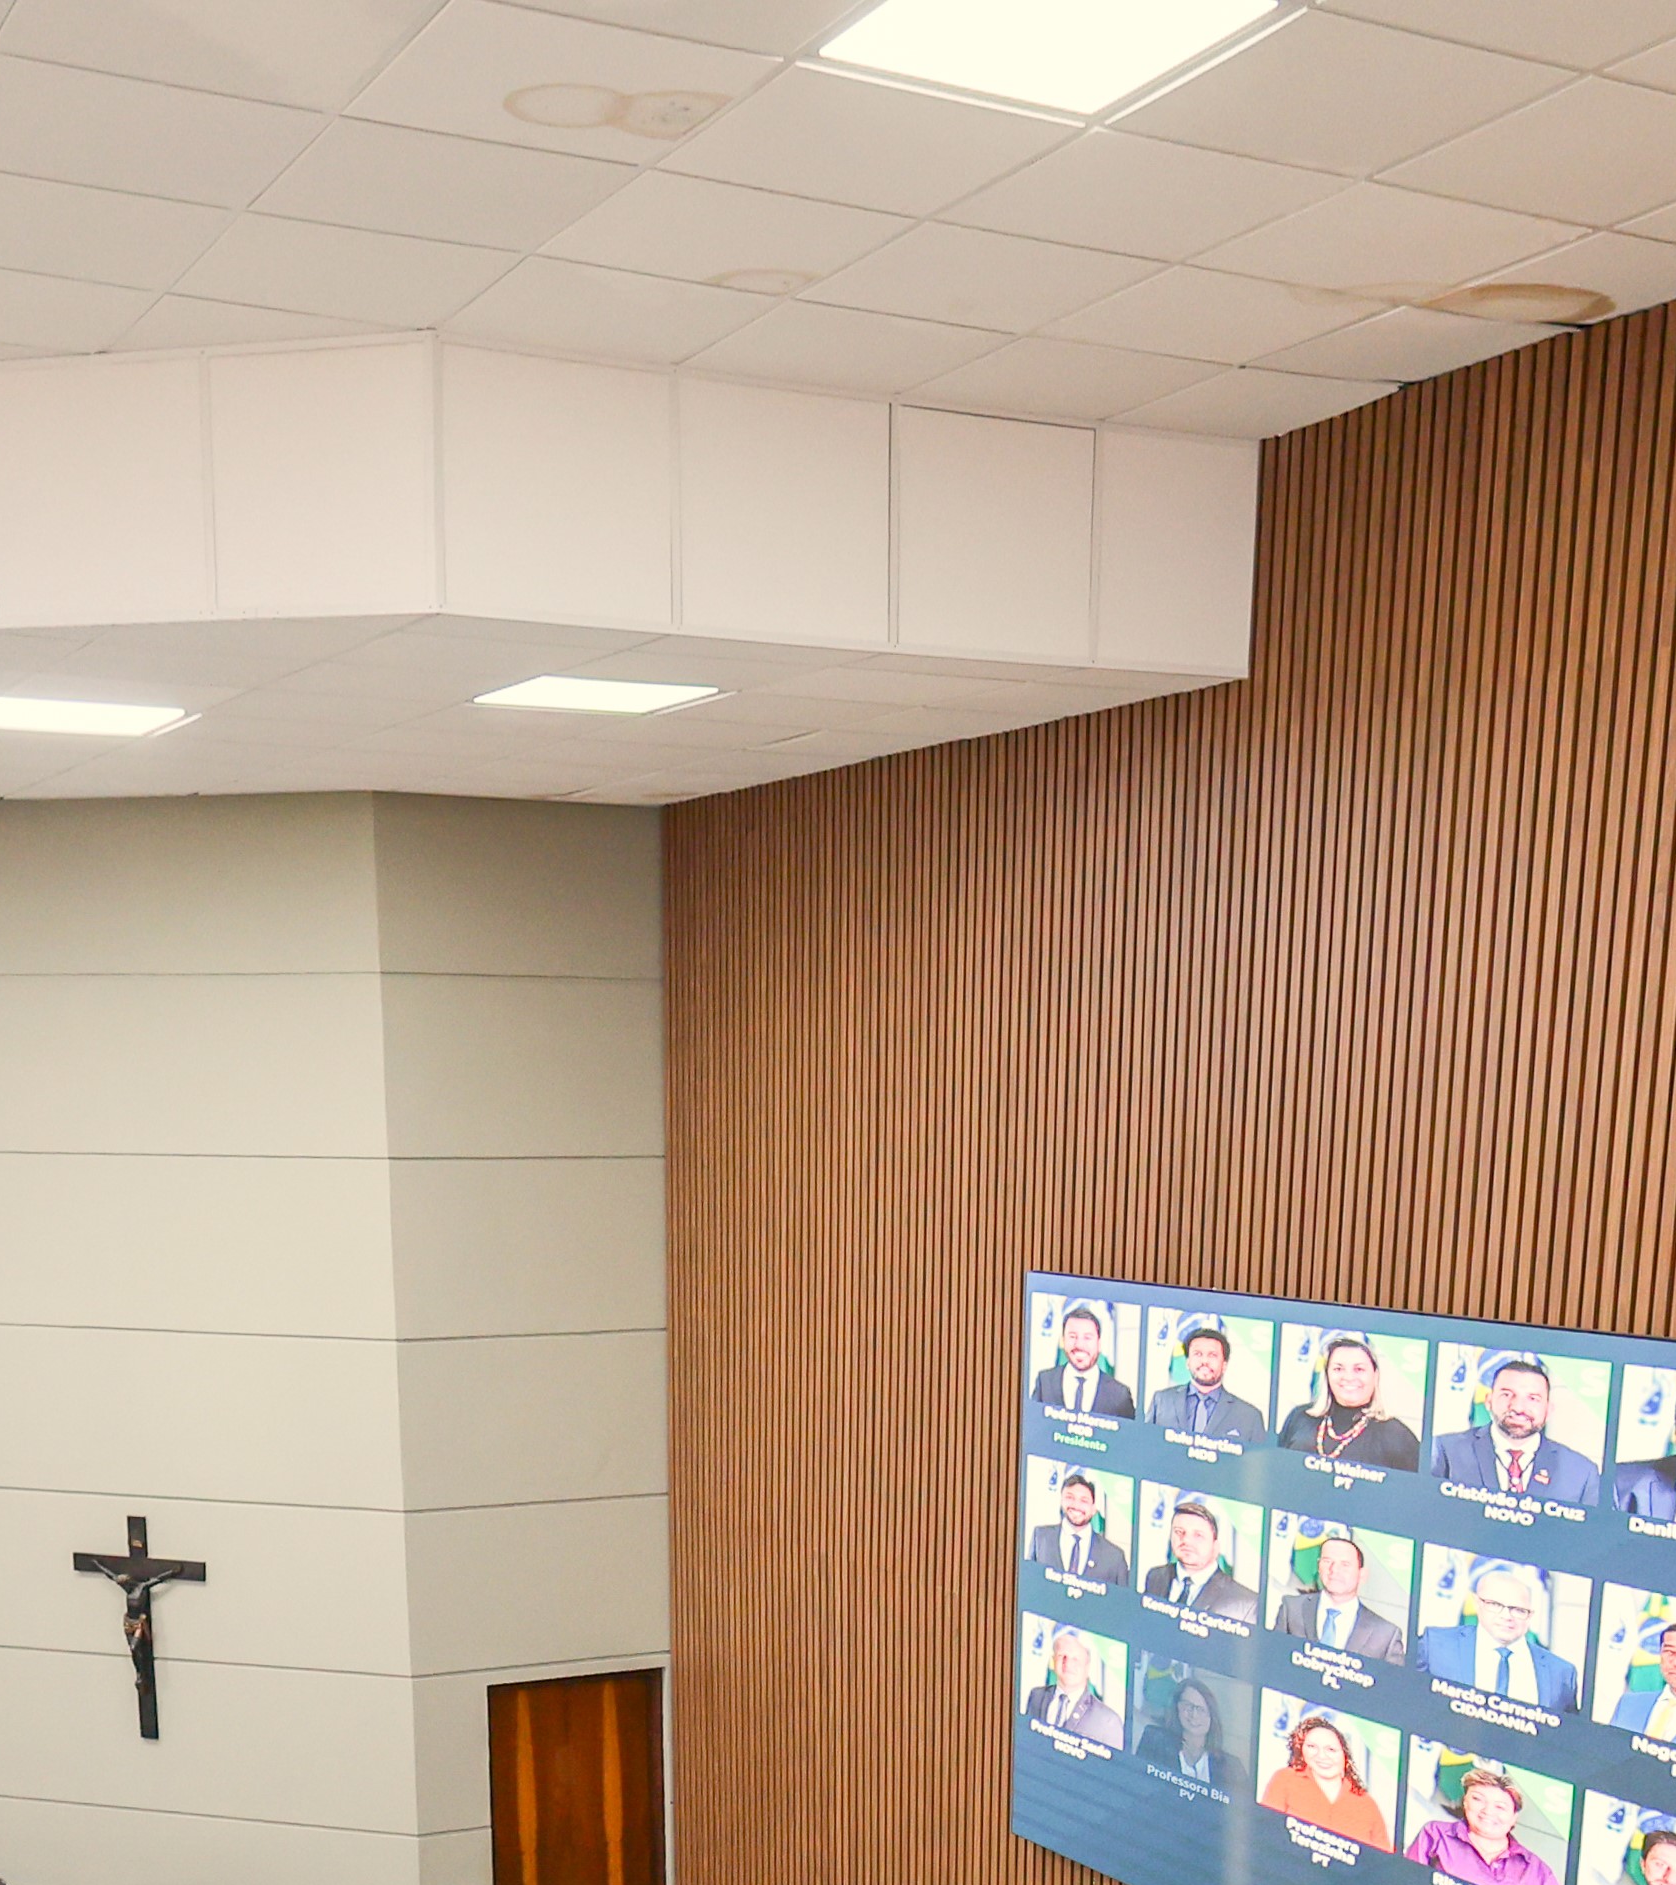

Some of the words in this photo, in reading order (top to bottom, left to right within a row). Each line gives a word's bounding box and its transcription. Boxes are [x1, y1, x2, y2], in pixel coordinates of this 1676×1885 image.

[1054, 1432, 1107, 1451] Presidente
[1187, 1446, 1217, 1463] MDB
[1304, 1456, 1333, 1473] Cris
[1334, 1475, 1354, 1490] PT
[1440, 1480, 1518, 1510] Cristóvão
[1518, 1495, 1542, 1514] da
[1543, 1500, 1586, 1523] Cruz
[1484, 1503, 1535, 1526] NOVO
[1142, 1595, 1179, 1619] Kenny
[1180, 1608, 1197, 1623] do
[1197, 1611, 1250, 1638] Cartório
[1180, 1620, 1209, 1638] MDB
[1304, 1642, 1363, 1670] Leandro
[1291, 1652, 1375, 1688] Dobrychtop
[1322, 1675, 1341, 1690] PL
[1431, 1678, 1486, 1706] Marcio
[1487, 1695, 1561, 1727] Carneiro
[1450, 1700, 1538, 1736] CIDADANIA
[1030, 1718, 1081, 1747] Professor
[1054, 1739, 1086, 1760] NOVO
[1146, 1763, 1210, 1797] Professora
[1210, 1788, 1231, 1805] Bia
[1178, 1787, 1195, 1802] PV
[1286, 1816, 1360, 1855] Professora
[1311, 1851, 1331, 1867] PT
